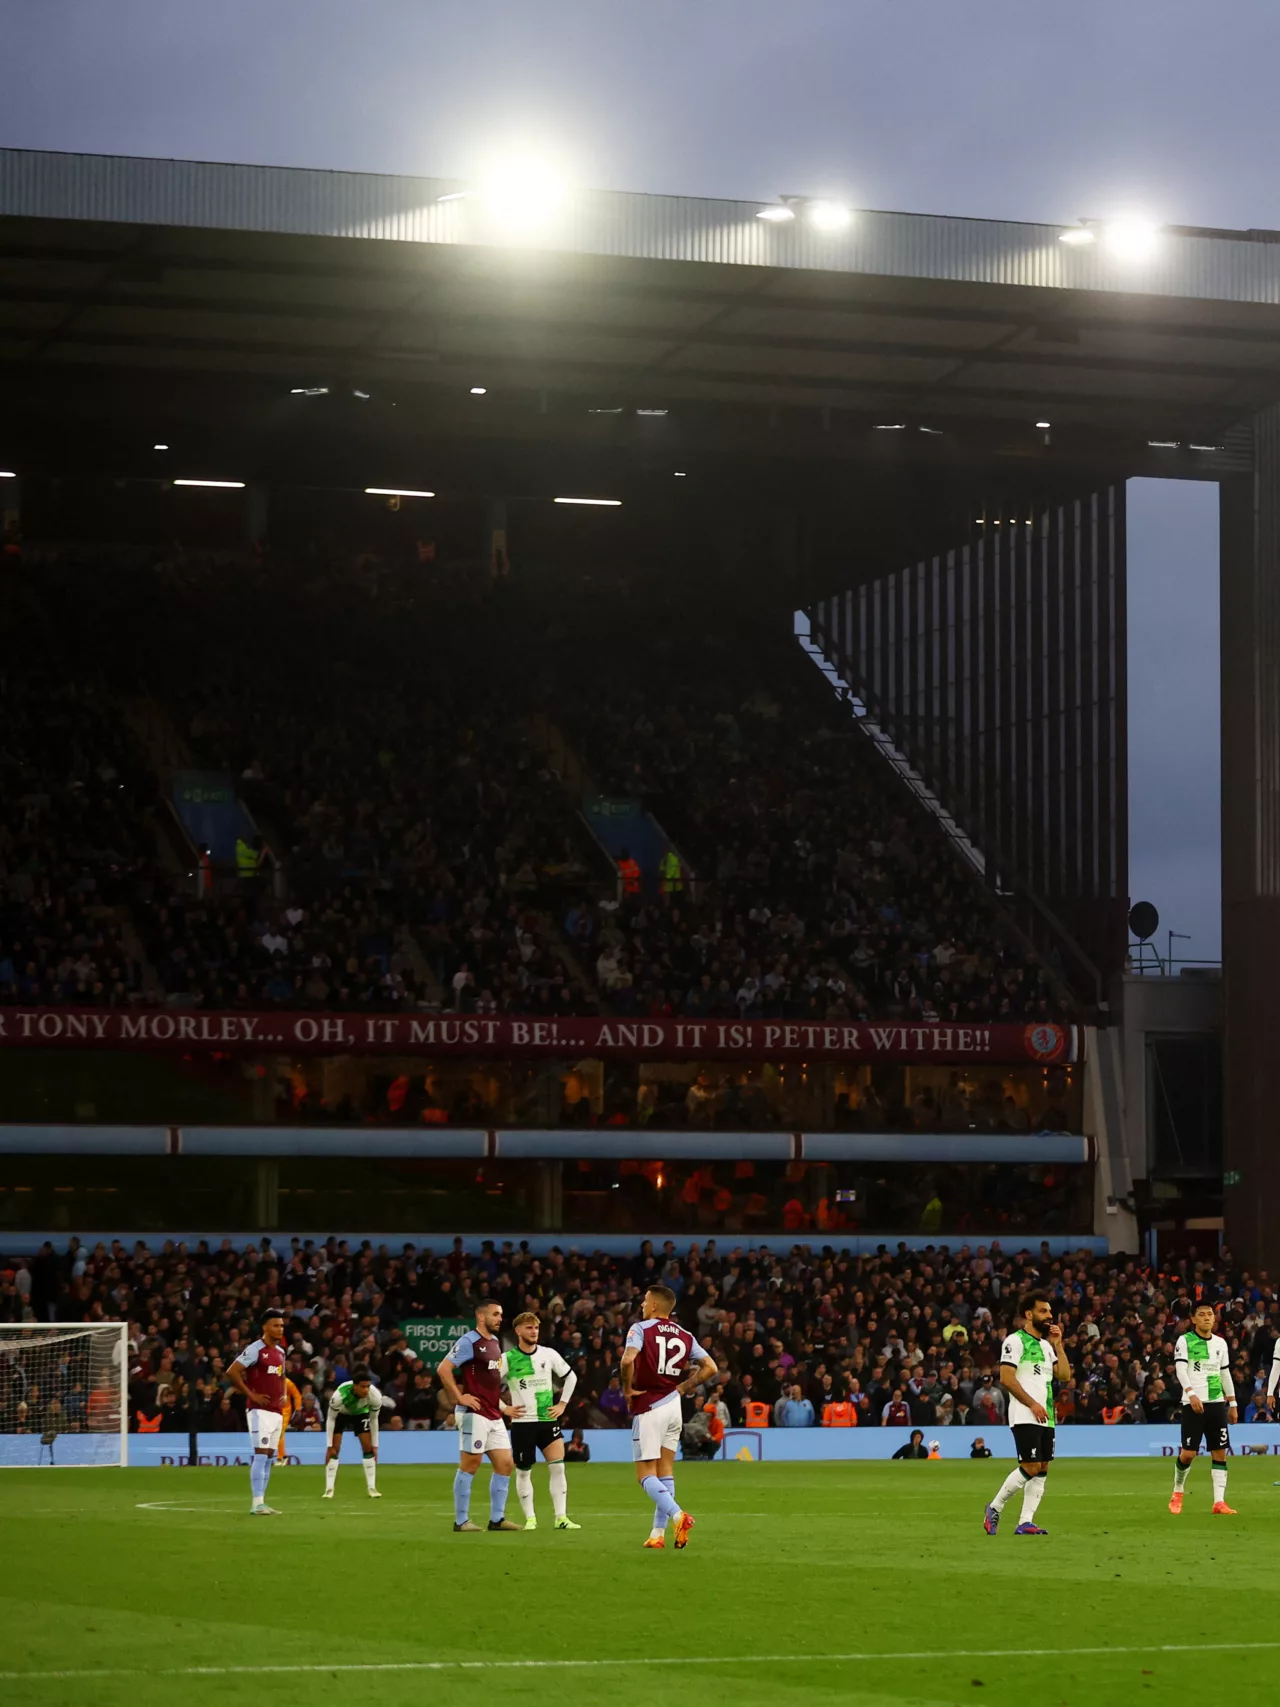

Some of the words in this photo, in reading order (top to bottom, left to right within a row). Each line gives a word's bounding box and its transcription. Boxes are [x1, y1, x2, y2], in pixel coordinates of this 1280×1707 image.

[16, 1012, 112, 1039] TONY
[120, 1014, 284, 1041] MORLEY...
[294, 1017, 356, 1046] OH,
[366, 1019, 400, 1044] IT
[409, 1020, 501, 1046] MUST
[511, 1021, 586, 1048] BE!...
[595, 1023, 665, 1048] AND
[674, 1025, 708, 1049] IT
[716, 1025, 753, 1049] IS!
[763, 1026, 862, 1051] PETER
[868, 1028, 991, 1053] WITHE!!
[405, 1324, 444, 1337] FIRST
[448, 1325, 471, 1337] AID
[657, 1324, 680, 1336] DIGNE
[419, 1339, 456, 1352] POST
[655, 1335, 687, 1377] 12
[1220, 1428, 1228, 1441] 3
